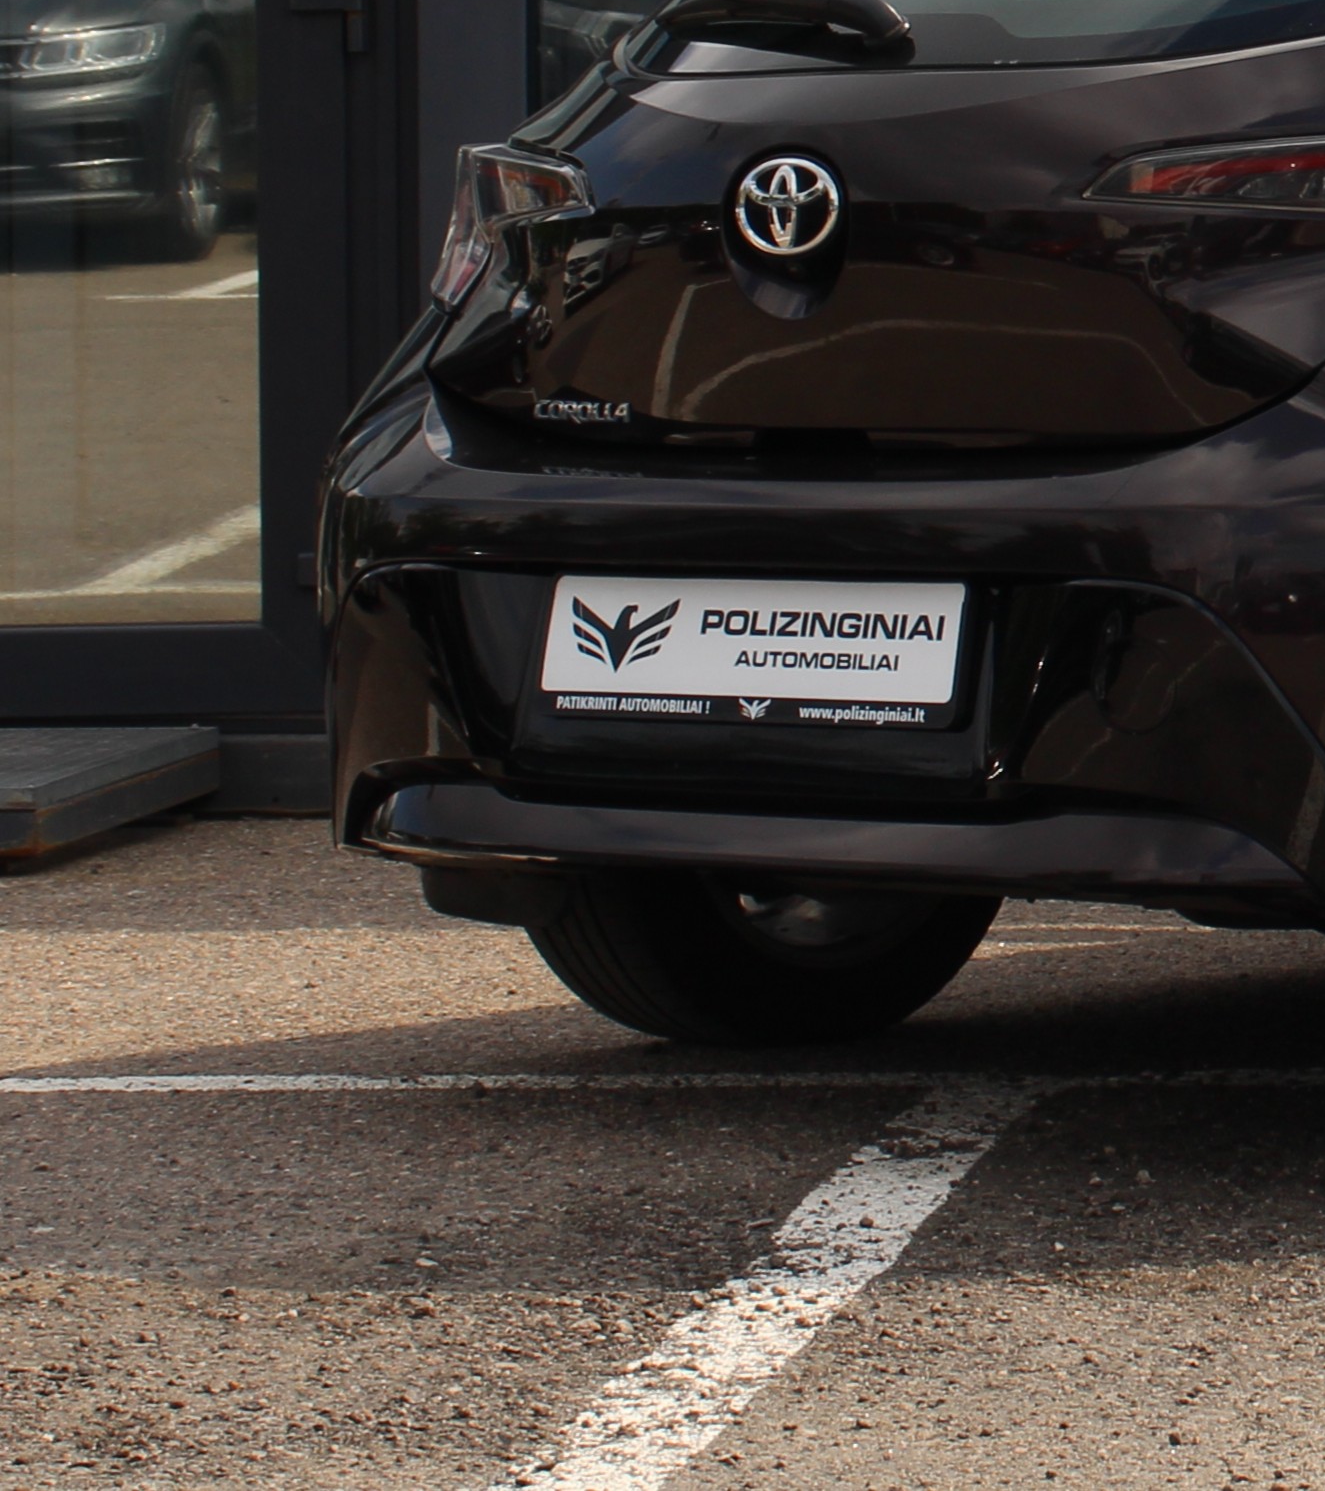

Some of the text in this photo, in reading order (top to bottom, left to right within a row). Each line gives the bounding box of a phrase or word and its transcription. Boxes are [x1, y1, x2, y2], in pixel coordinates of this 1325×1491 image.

[534, 399, 631, 424] COROLLA
[700, 609, 945, 641] POLIZINGINIAI
[734, 651, 899, 671] AUTOMOBILIAI
[556, 695, 618, 712] PATIKRINTI
[619, 697, 703, 714] AUTOMOBILIAI
[798, 705, 925, 724] www.polizinginiai.lt
